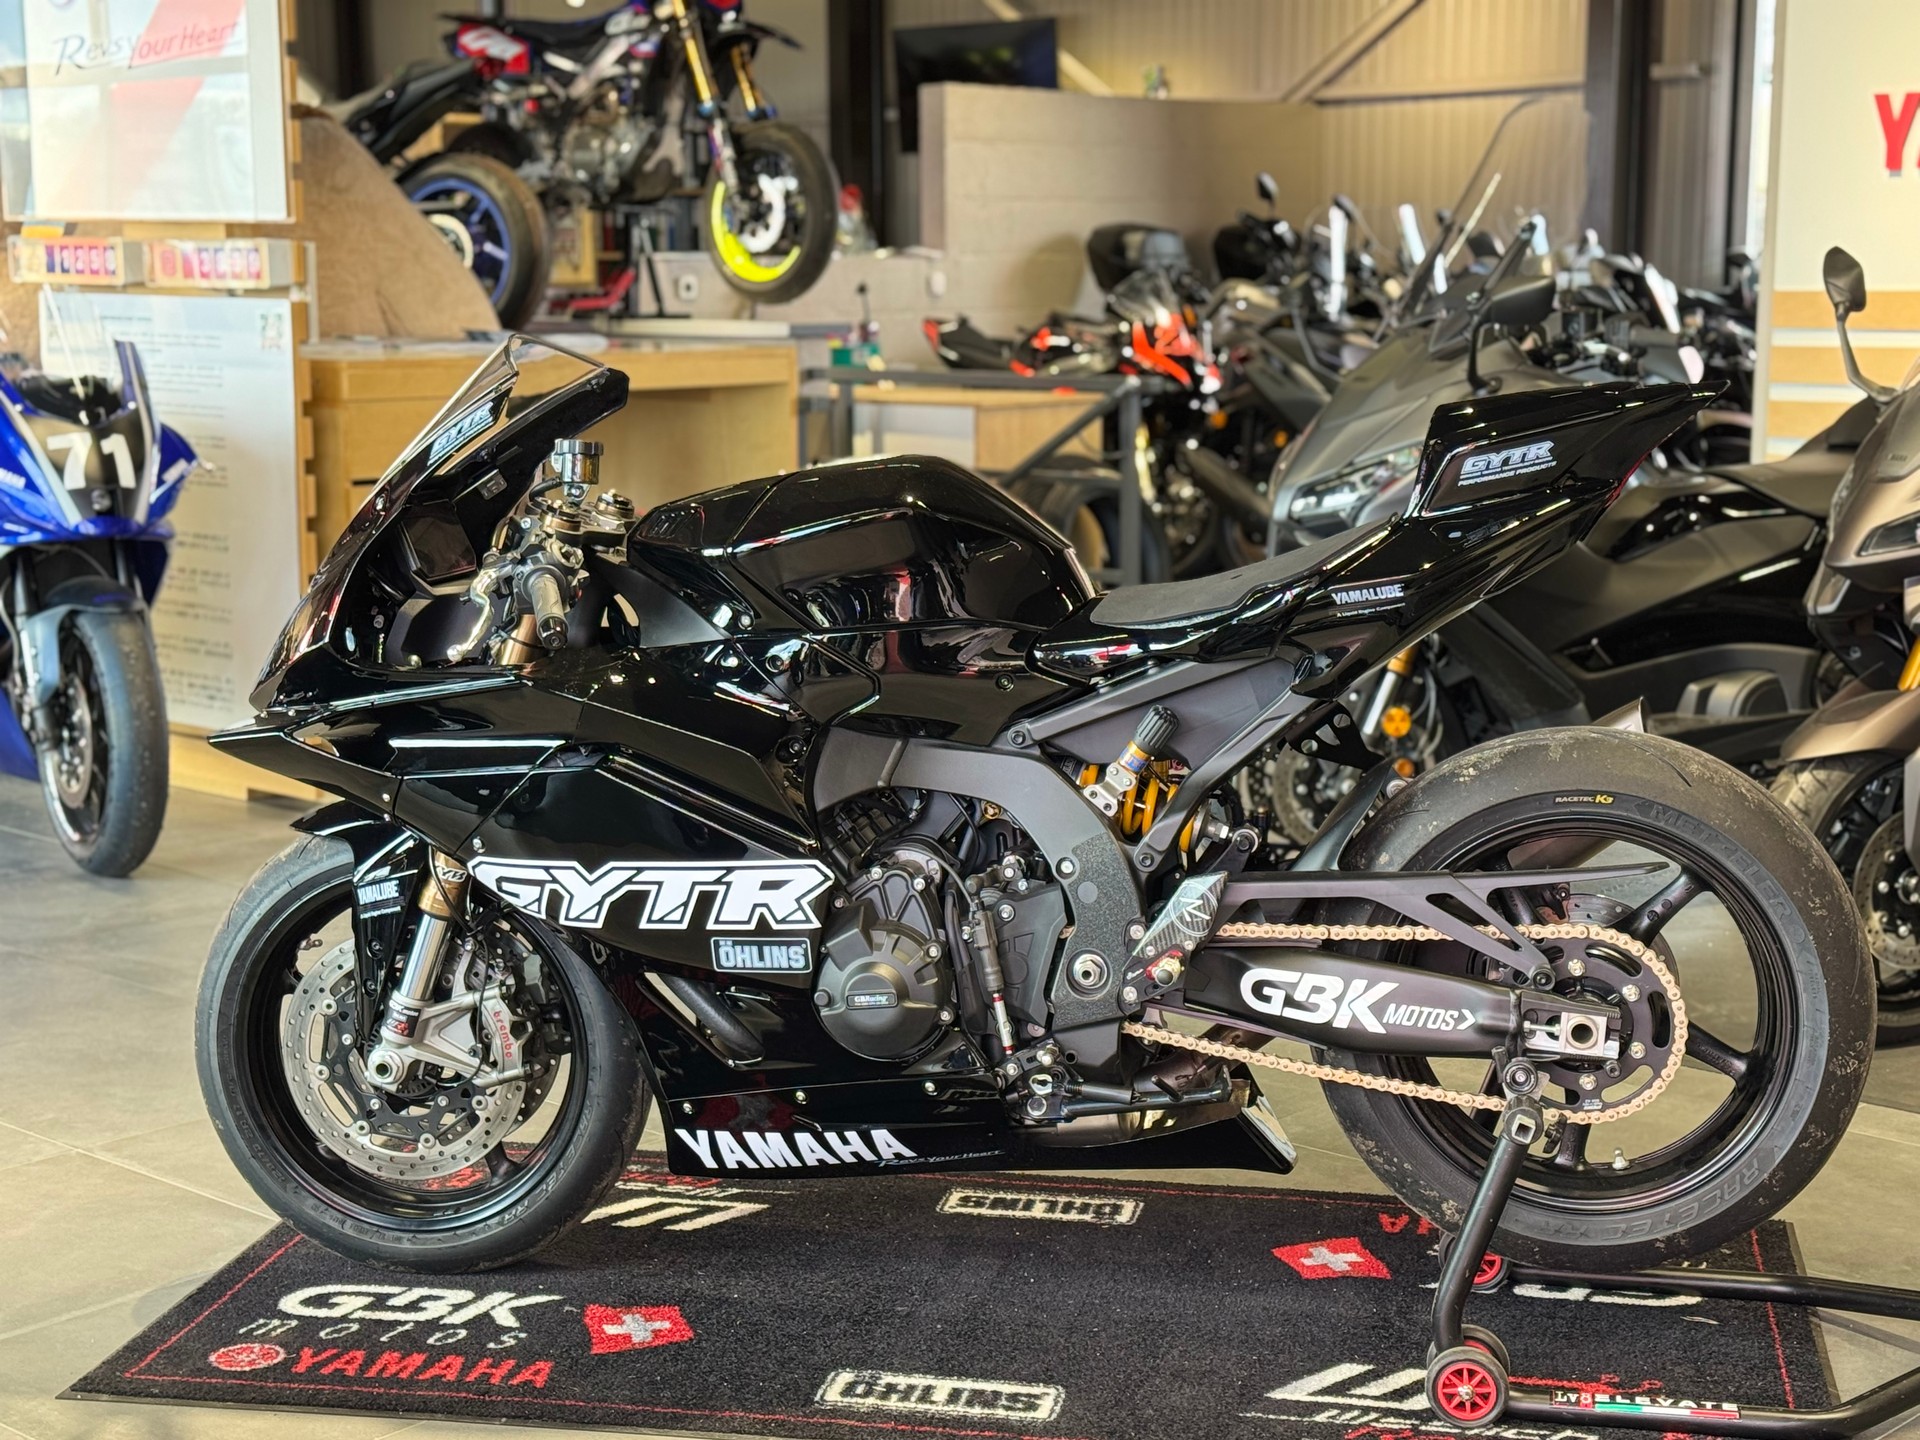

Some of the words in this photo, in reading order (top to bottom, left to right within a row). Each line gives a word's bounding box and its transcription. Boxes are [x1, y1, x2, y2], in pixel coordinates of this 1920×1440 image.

[46, 431, 136, 490] 71
[1458, 469, 1515, 486] PERFORMANCE
[1516, 461, 1558, 476] PRODUCTS
[1461, 441, 1555, 475] GYTR
[1331, 584, 1404, 605] YAMALUBE
[357, 880, 400, 905] YAMALUBE
[467, 857, 835, 931] GYTR
[718, 940, 807, 968] ÖHLINS
[1240, 968, 1399, 1034] GBK
[1383, 1003, 1459, 1031] MOTOS
[493, 1010, 513, 1059] brembo
[674, 1128, 918, 1169] YAMAHA
[277, 1284, 563, 1328] GBK
[290, 1347, 555, 1388] YAMAHA
